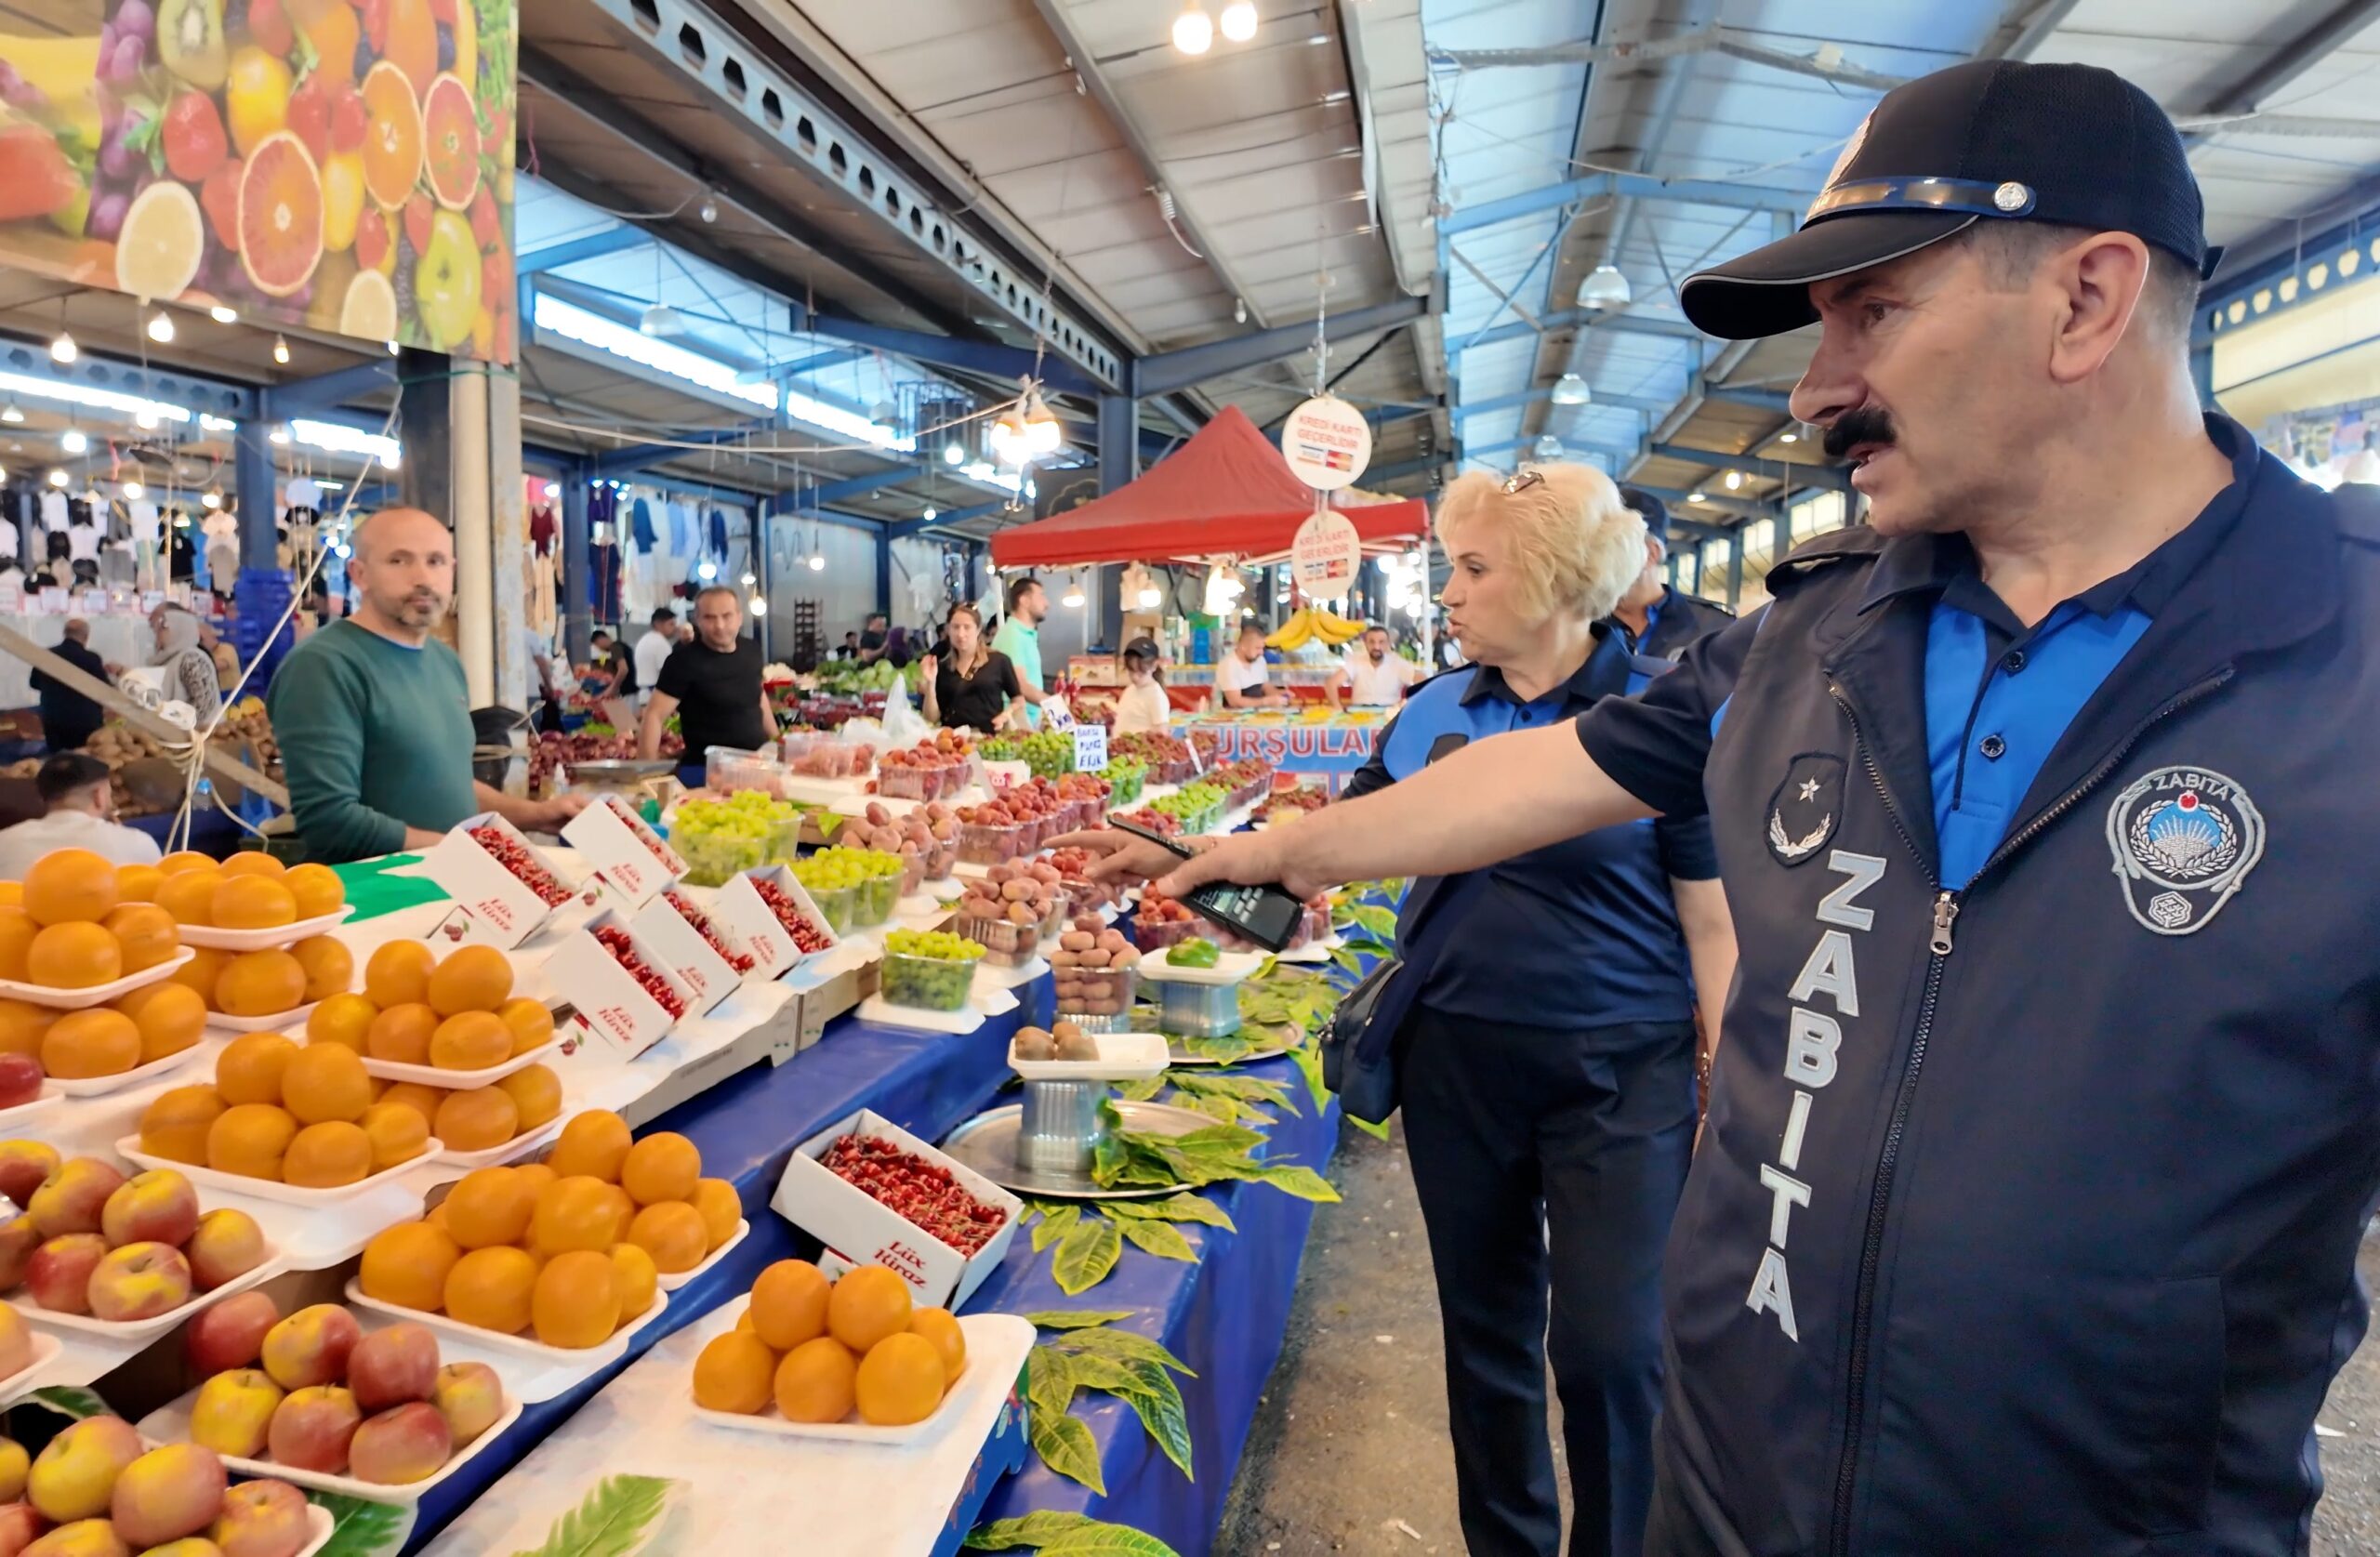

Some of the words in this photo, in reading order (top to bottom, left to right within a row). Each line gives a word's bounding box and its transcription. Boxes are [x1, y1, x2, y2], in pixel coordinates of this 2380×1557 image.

[2152, 772, 2229, 801] ZABITA
[1746, 851, 1887, 1342] ZABITA
[874, 1248, 927, 1289] Kiraz
[889, 1240, 926, 1271] Lüx
